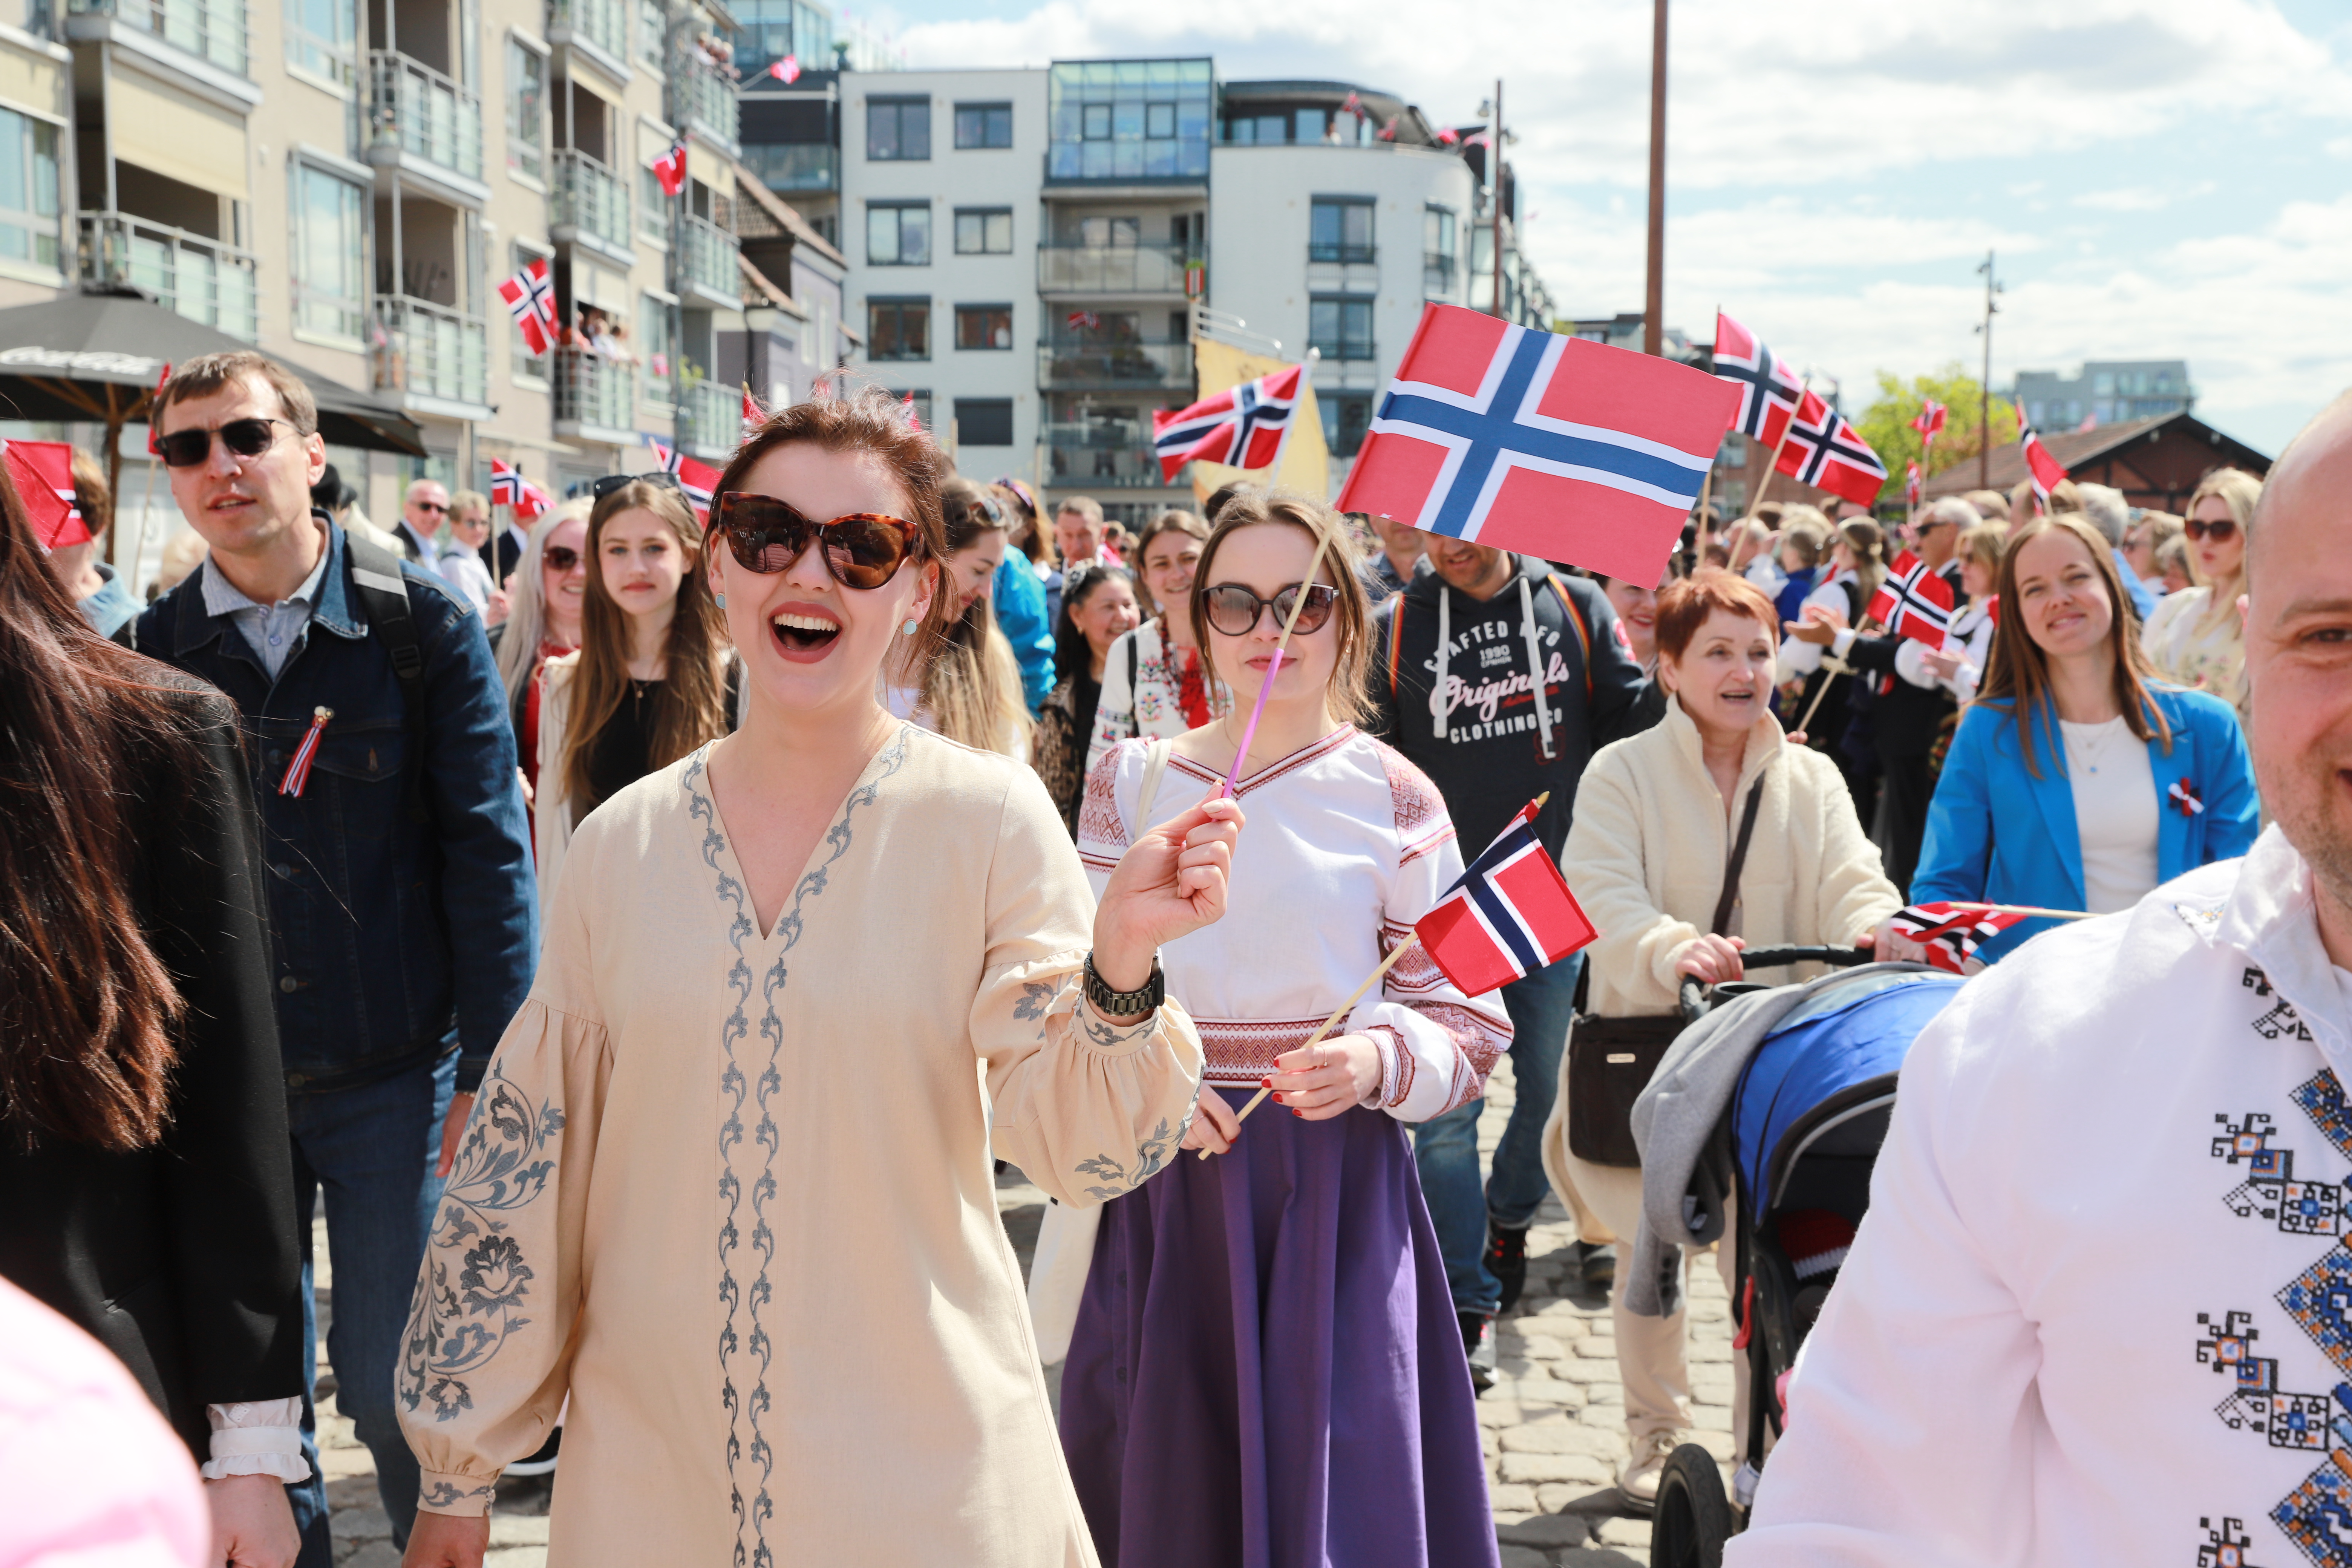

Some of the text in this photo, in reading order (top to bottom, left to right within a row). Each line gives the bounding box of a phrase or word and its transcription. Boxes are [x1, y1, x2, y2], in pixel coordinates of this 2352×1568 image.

[1424, 620, 1508, 672] CAFTED
[1479, 645, 1510, 660] 1990
[1450, 714, 1537, 744] CLOTHING
